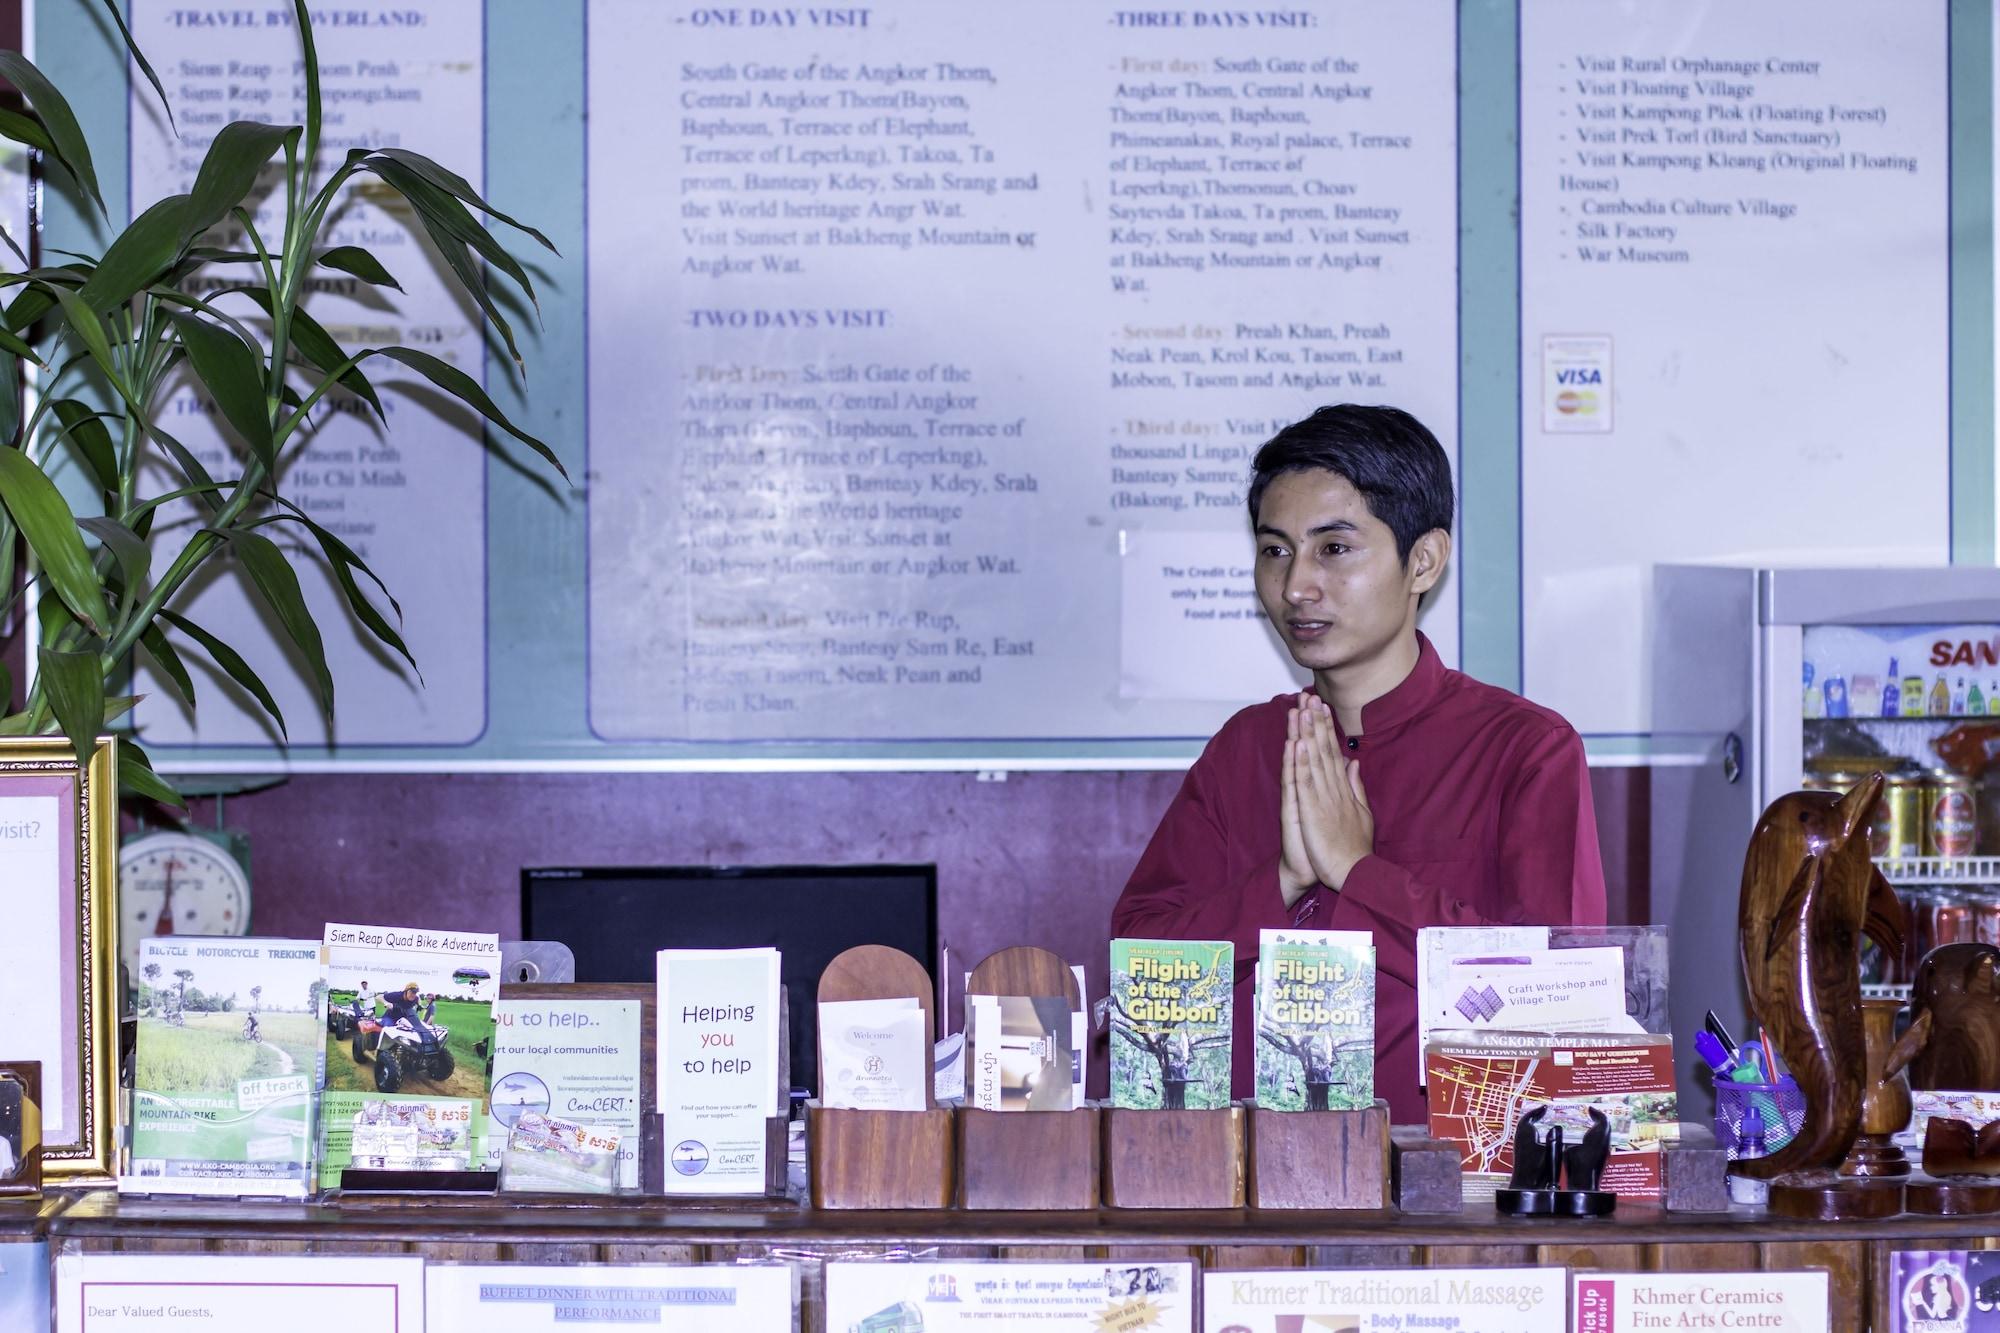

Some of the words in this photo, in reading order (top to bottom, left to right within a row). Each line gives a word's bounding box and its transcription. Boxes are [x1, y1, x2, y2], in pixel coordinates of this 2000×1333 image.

[690, 9, 741, 26] ONE
[750, 9, 799, 27] DAY
[808, 9, 871, 28] VISIT
[1193, 12, 1249, 27] DAYS
[681, 63, 737, 81] South
[742, 63, 787, 81] Gate
[799, 62, 817, 81] of
[820, 63, 849, 81] the
[856, 64, 928, 85] Angkor
[935, 62, 997, 85] Thom,
[1577, 56, 1615, 72] Visit
[1622, 56, 1666, 72] Rural
[1672, 58, 1760, 77] Orphanage
[1765, 60, 1820, 73] Center
[1577, 80, 1615, 98] Visit
[1621, 80, 1689, 102] Floating
[1695, 80, 1754, 102] Village
[1576, 128, 1616, 145] Visit
[1621, 128, 1658, 145] Prek
[1703, 128, 1747, 149] (Bird
[1752, 129, 1840, 149] Sanctuary)
[681, 200, 711, 218] the
[718, 200, 778, 218] World
[783, 200, 861, 222] heritage
[1582, 199, 1666, 216] Cambodia
[1670, 199, 1732, 216] Culture
[1738, 200, 1796, 220] Village
[1576, 222, 1609, 238] Silk
[1615, 222, 1677, 244] Factory
[1578, 246, 1611, 262] War
[1618, 246, 1689, 262] Museum
[754, 309, 818, 328] DAYS
[825, 310, 886, 328] VISIT
[1111, 348, 1154, 363] Neak
[1211, 348, 1249, 363] Krol
[1367, 347, 1403, 363] East
[1556, 368, 1602, 385] VISA
[1163, 567, 1185, 577] The
[1188, 567, 1225, 577] Credit
[1171, 588, 1198, 600] only
[1201, 587, 1218, 598] for
[1184, 608, 1215, 619] Food
[1219, 610, 1242, 619] and
[330, 930, 356, 943] Siem
[358, 931, 383, 948] Reap
[386, 933, 413, 947] Quad
[416, 935, 438, 949] Bike
[442, 938, 495, 953] Adventure
[149, 946, 188, 957] BICYCLE
[197, 947, 260, 959] MOTORCYCLE
[269, 949, 316, 961] TREKKING
[1129, 957, 1201, 983] Flight
[1273, 959, 1345, 985] Flight
[1128, 981, 1147, 998] of
[1151, 981, 1181, 999] the
[1272, 984, 1291, 1001] of
[1296, 984, 1326, 1001] the
[1508, 985, 1533, 995] Craft
[1536, 981, 1587, 993] Workshop
[1589, 978, 1608, 988] and
[1510, 995, 1544, 1007] Village
[1549, 994, 1570, 1003] Tour
[520, 1012, 542, 1026] to
[683, 1004, 755, 1023] Helping
[1127, 999, 1217, 1022] Gibbon
[1272, 1001, 1361, 1025] Gibbon
[701, 1033, 735, 1048] you
[853, 1031, 895, 1040] Welcome
[1481, 1035, 1537, 1047] ANGKOR
[1538, 1036, 1589, 1048] TEMPLE
[1591, 1038, 1620, 1048] MAP
[509, 1047, 526, 1055] our
[529, 1045, 552, 1055] local
[555, 1045, 619, 1055] communities
[1441, 1047, 1464, 1055] SIEM
[1466, 1048, 1490, 1056] REAP
[1491, 1049, 1518, 1057] TOWN
[683, 1060, 705, 1074] to
[712, 1058, 752, 1075] help
[243, 1082, 261, 1096] off
[266, 1079, 304, 1094] track
[140, 1097, 153, 1106] AN
[139, 1110, 191, 1120] MOUNTAIN
[194, 1111, 217, 1121] BIKE
[138, 1121, 197, 1132] EXPERIENCE
[480, 1287, 533, 1299] BUFFET
[537, 1287, 592, 1300] DINNER
[596, 1288, 634, 1300] WITH
[640, 1288, 736, 1301] TRADITIONAL
[1231, 1279, 1308, 1305] Khmer
[1315, 1279, 1440, 1305] Traditional
[1448, 1280, 1545, 1312] Massage
[1583, 1288, 1600, 1307] Up
[1632, 1288, 1696, 1305] Khmer
[1700, 1287, 1784, 1305] Ceramics
[88, 1305, 118, 1318] Dear
[122, 1305, 164, 1318] Valued
[167, 1305, 214, 1319] Guests,
[555, 1307, 661, 1319] PERFORMANCE
[1632, 1310, 1672, 1328] Fine
[1677, 1311, 1716, 1328] Arts
[1721, 1310, 1784, 1328] Centre
[1371, 1313, 1403, 1330] Body
[1406, 1314, 1461, 1330] Massage
